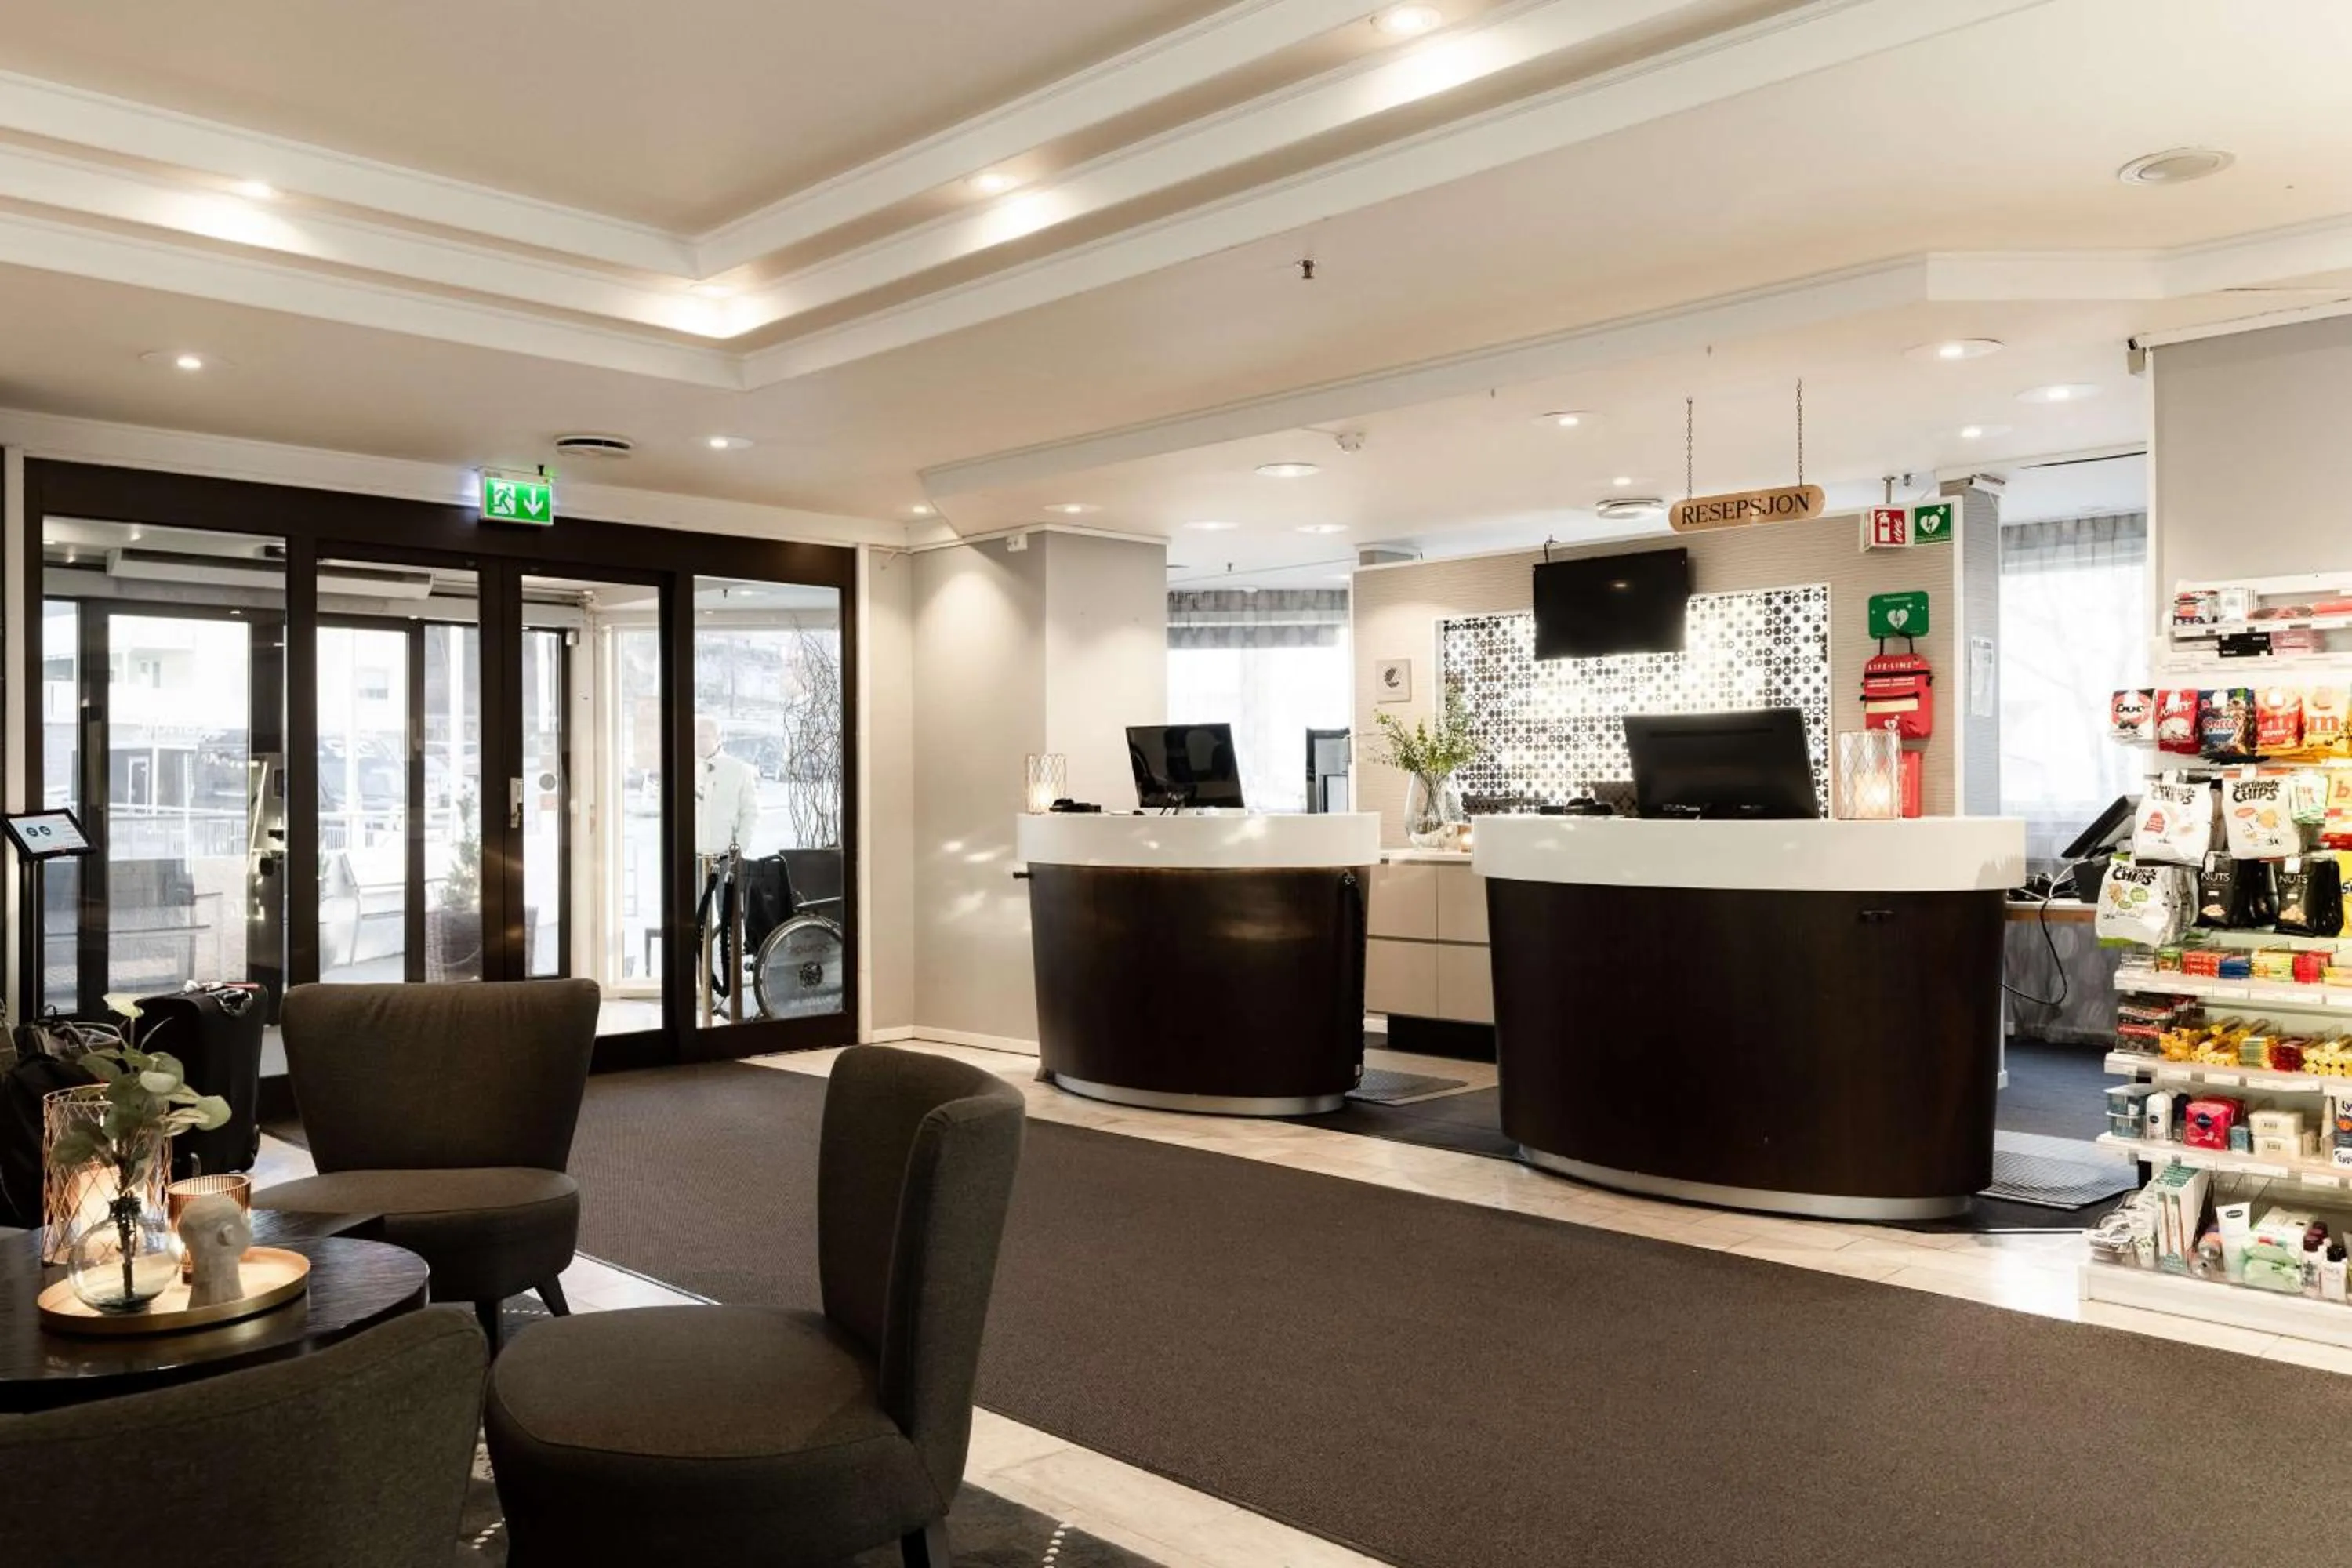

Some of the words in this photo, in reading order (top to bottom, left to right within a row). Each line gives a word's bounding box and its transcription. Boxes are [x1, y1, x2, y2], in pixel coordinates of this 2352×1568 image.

[1682, 492, 1810, 525] RESEPSJON
[2233, 786, 2278, 803] CHIPS
[2201, 872, 2230, 882] NUTS
[2278, 873, 2309, 884] NUTS
